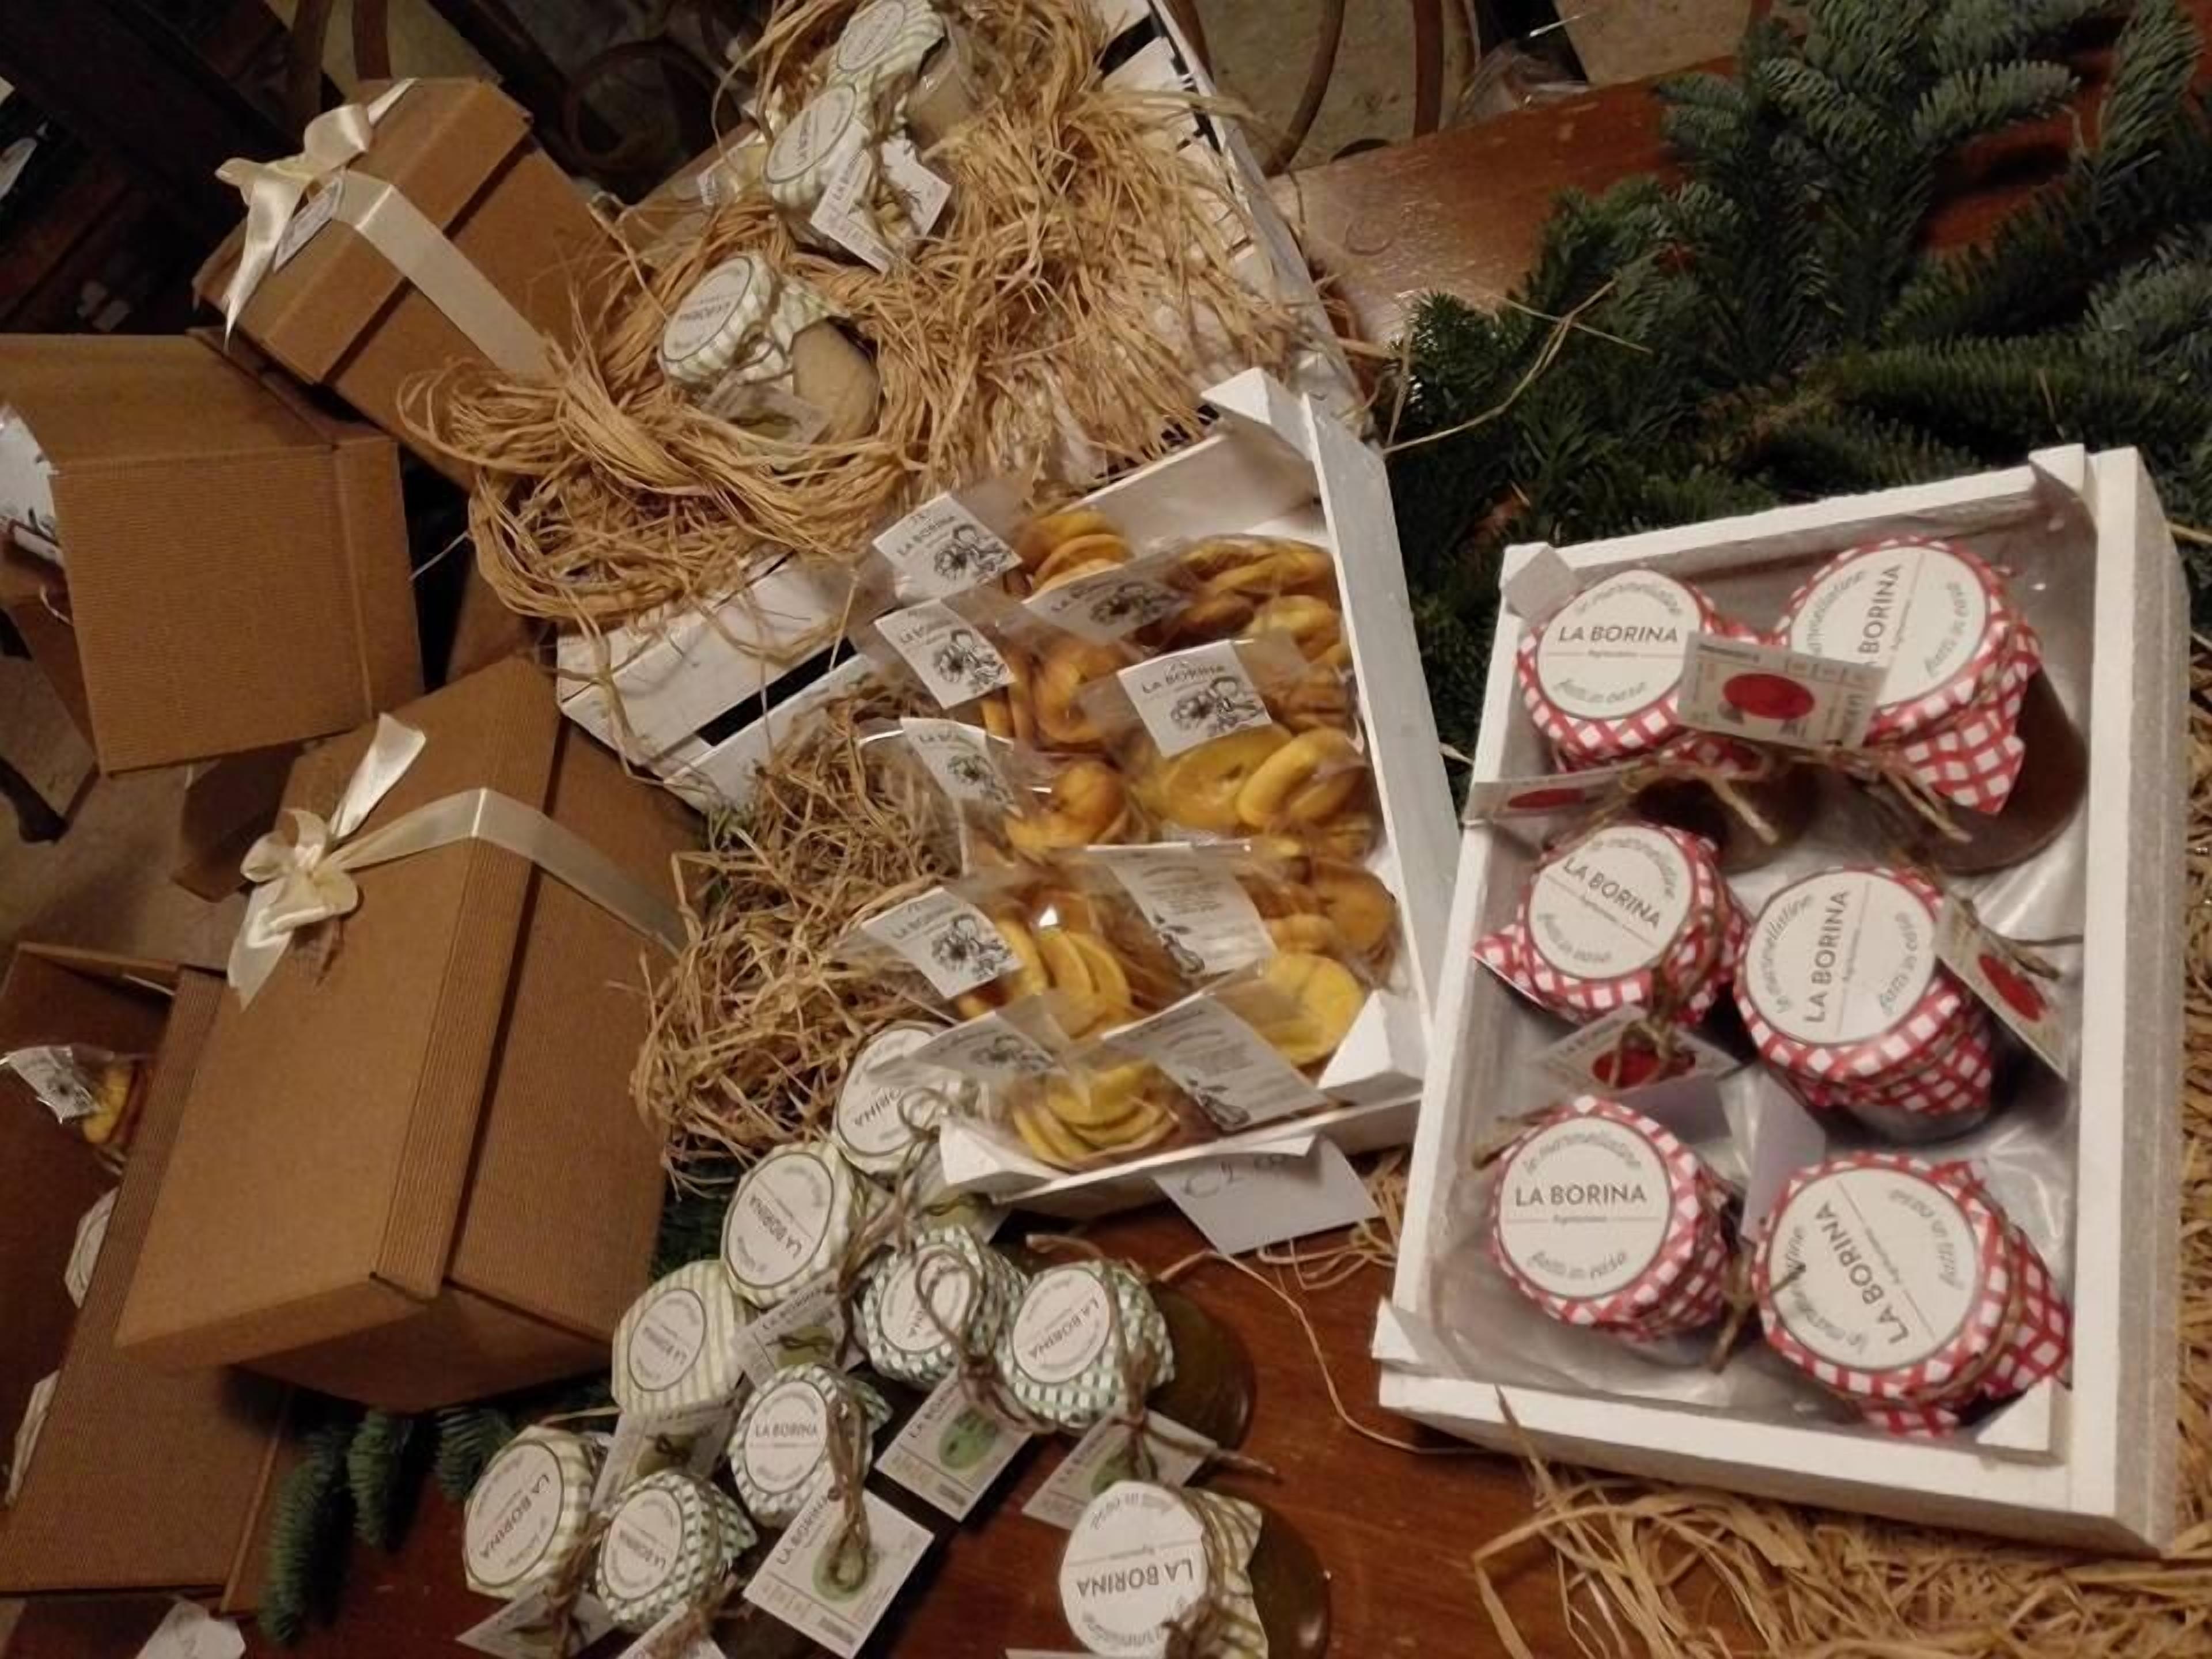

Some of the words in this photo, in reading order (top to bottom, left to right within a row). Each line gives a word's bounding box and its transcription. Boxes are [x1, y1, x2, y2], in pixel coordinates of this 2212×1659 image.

[1858, 563, 1903, 654] BORINA
[1559, 626, 1584, 642] LA
[1590, 625, 1677, 643] BORINA
[1563, 857, 1588, 881] LA
[1589, 871, 1660, 929] BORINA
[1811, 892, 1851, 984] BORINA
[1804, 991, 1828, 1022] LA
[1515, 1186, 1545, 1207] LA
[1550, 1183, 1648, 1206] BORINA
[786, 1237, 802, 1260] LA
[1815, 1200, 1884, 1305] BORINA
[1878, 1302, 1910, 1343] LA
[755, 1423, 770, 1437] LA
[532, 1473, 550, 1494] LA
[1076, 1565, 1160, 1597] BORINA
[1165, 1558, 1194, 1582] LA
